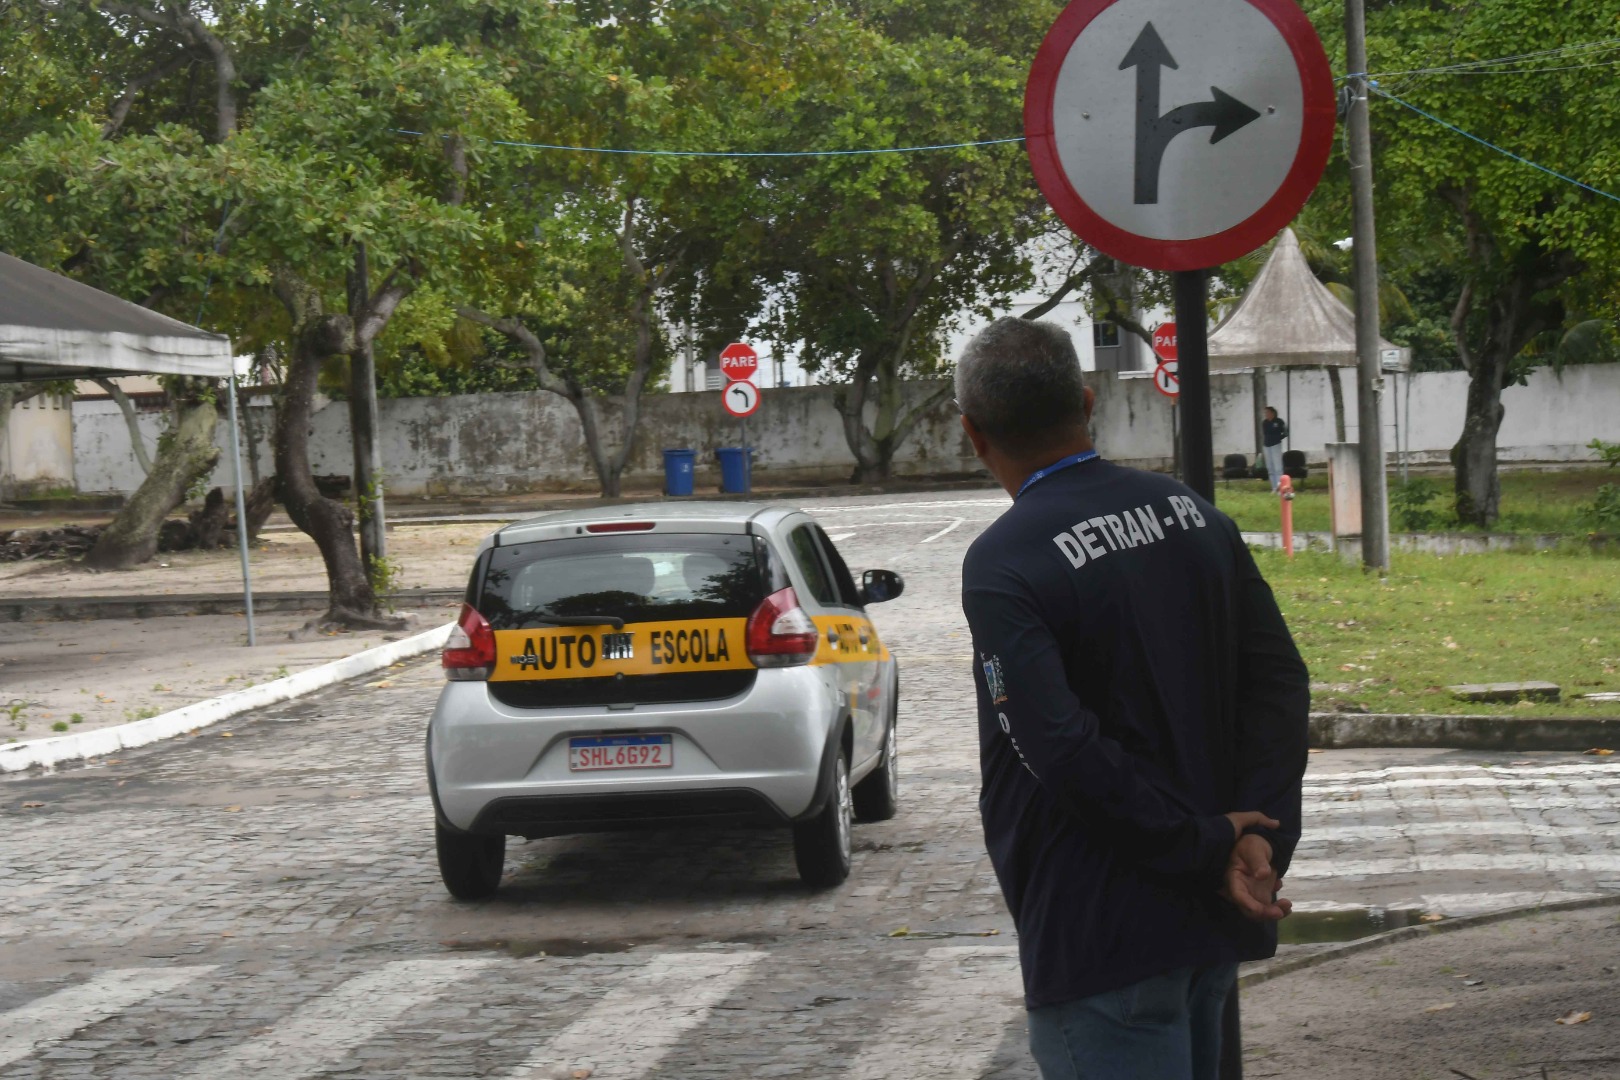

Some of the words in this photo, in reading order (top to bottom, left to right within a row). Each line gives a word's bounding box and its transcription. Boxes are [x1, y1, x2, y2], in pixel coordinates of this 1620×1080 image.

[722, 355, 756, 369] PARE
[520, 634, 596, 671] AUTO
[651, 628, 730, 664] ESCOLA
[580, 745, 662, 767] SHL6G92
